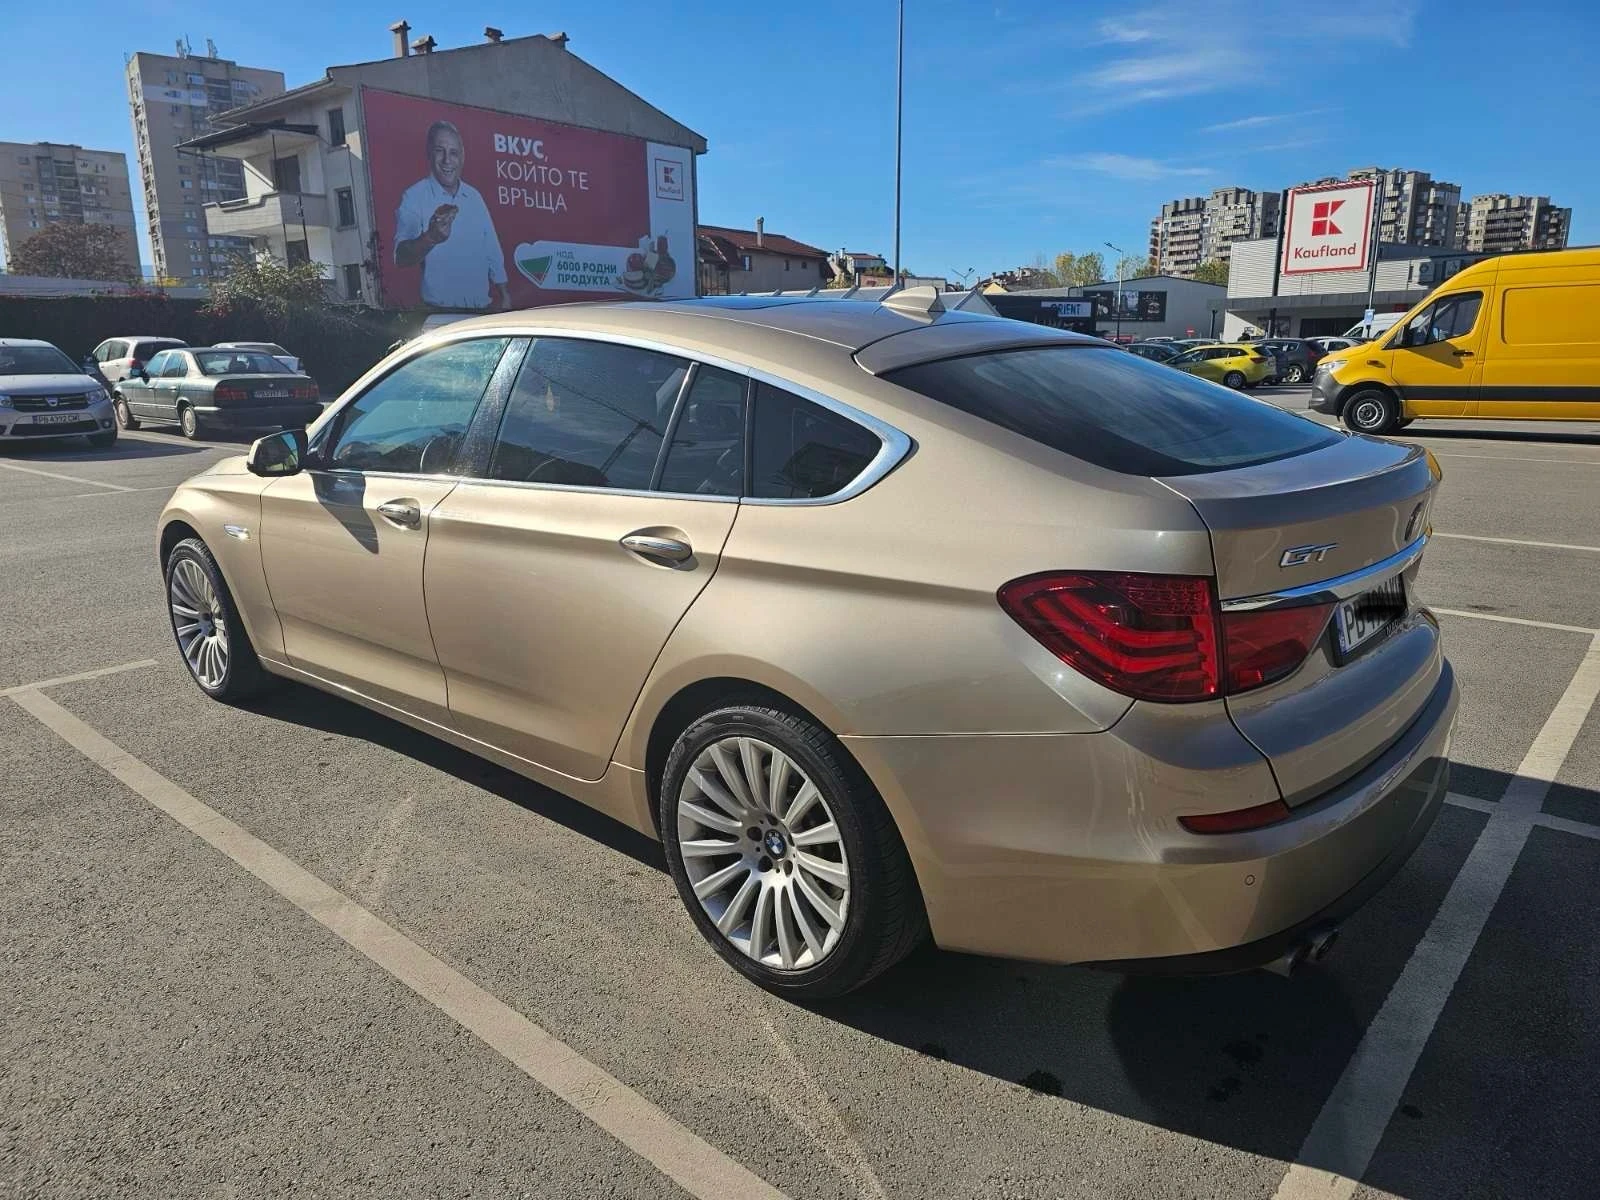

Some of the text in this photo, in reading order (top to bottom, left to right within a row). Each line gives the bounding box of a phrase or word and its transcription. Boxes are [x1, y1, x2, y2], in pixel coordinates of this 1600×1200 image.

[494, 132, 549, 162] ВКУС,
[496, 159, 589, 190] КОЙТО ТЕ
[498, 185, 568, 214] ВРЪЩА
[1294, 242, 1357, 260] Kaufland
[556, 261, 617, 274] 6000 РОДНИ
[557, 273, 610, 287] ПРОДУКТА
[1279, 542, 1337, 568] GT
